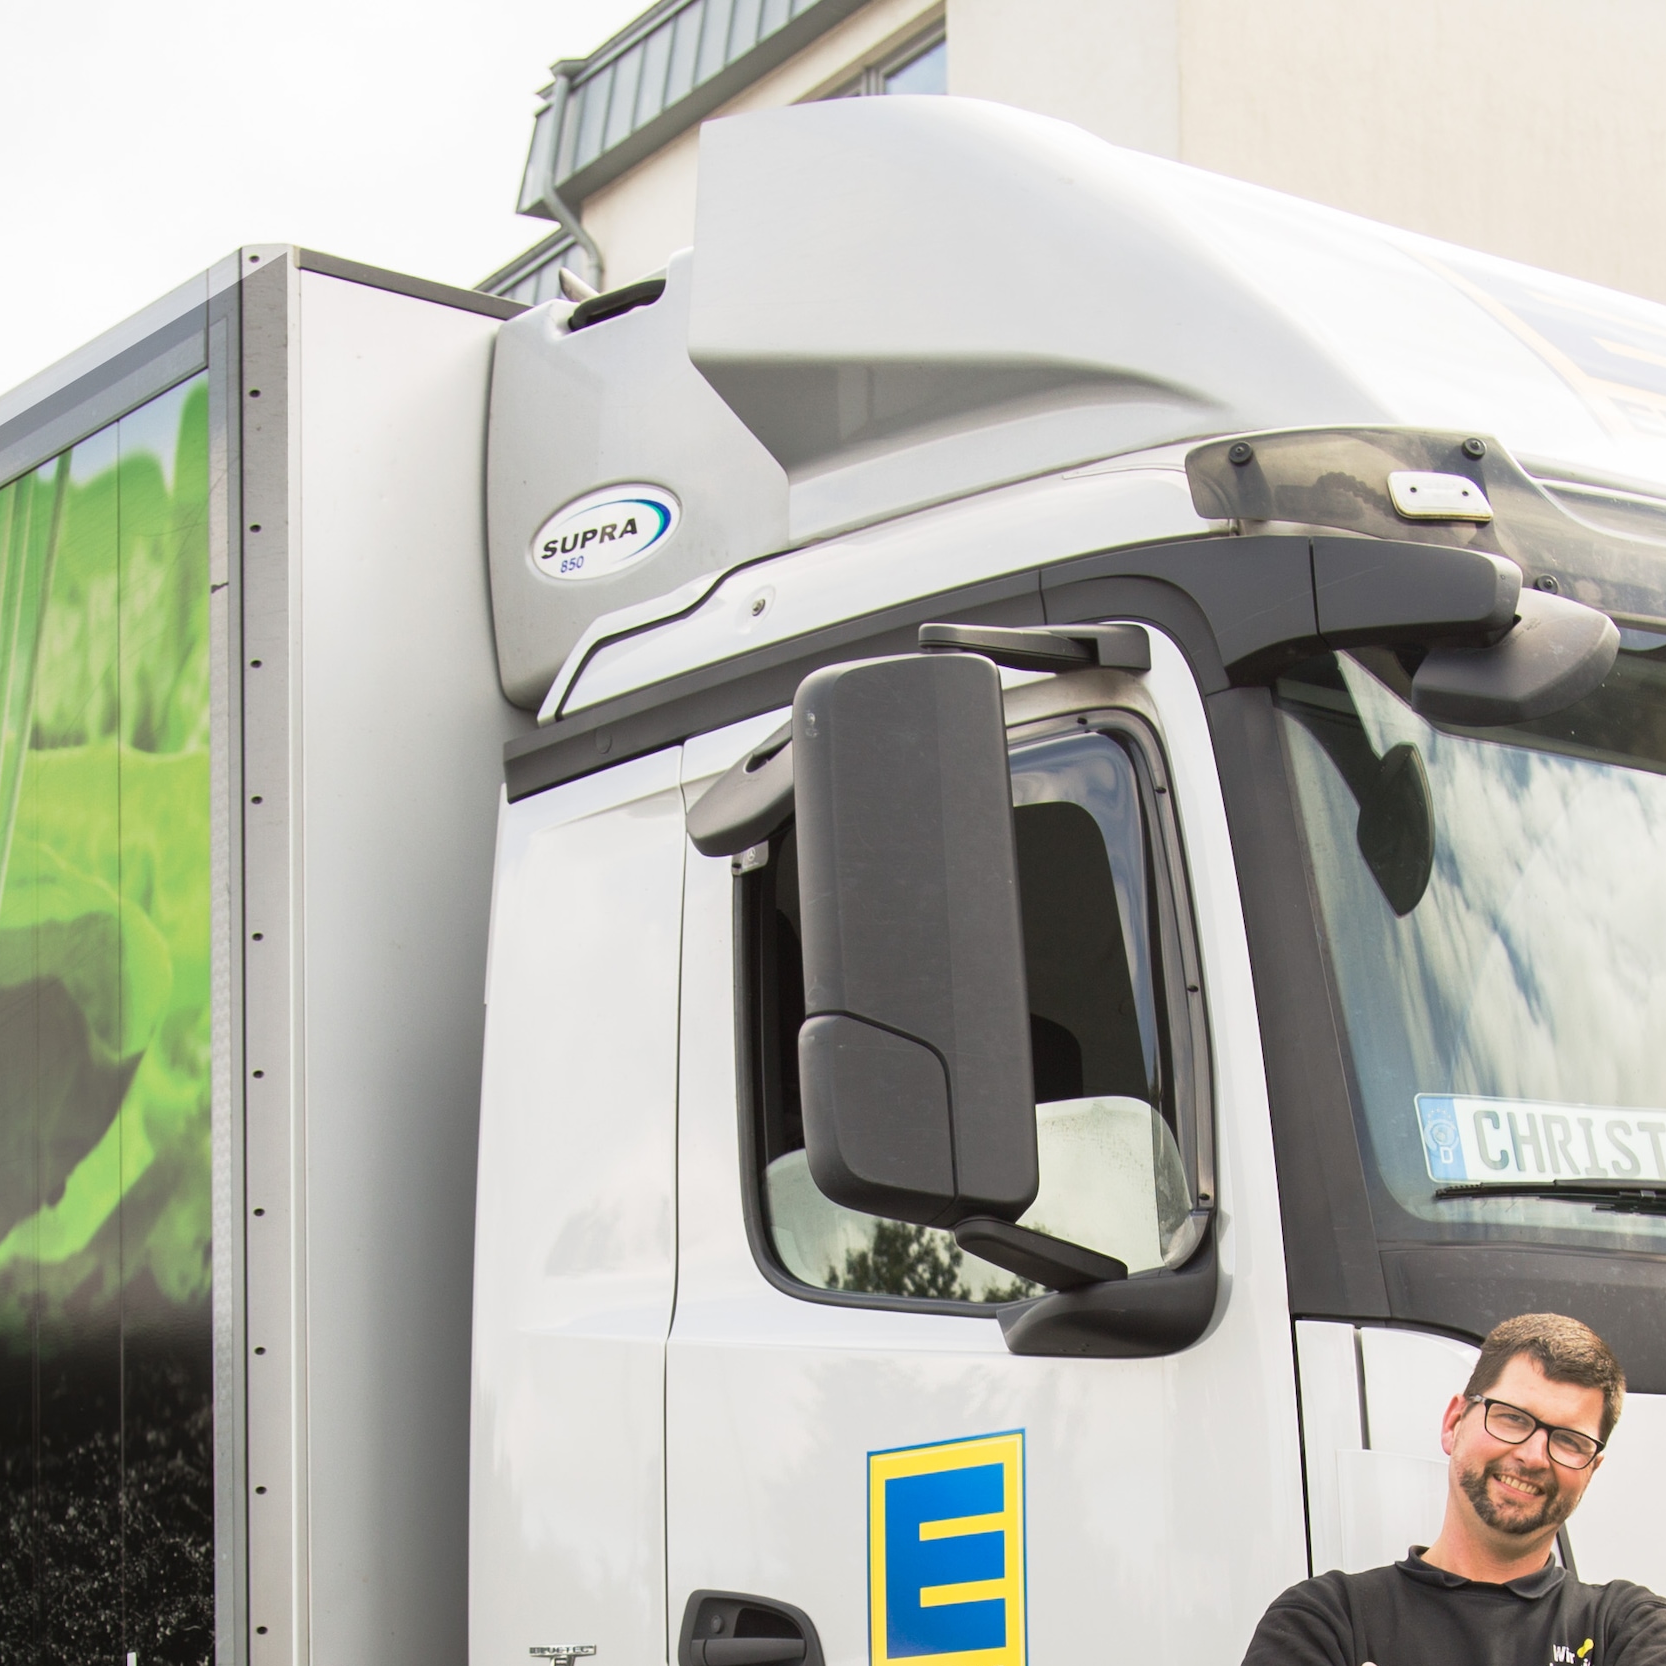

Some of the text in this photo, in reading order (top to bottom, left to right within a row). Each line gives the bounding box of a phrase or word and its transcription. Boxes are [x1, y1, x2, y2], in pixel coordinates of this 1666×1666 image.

[541, 517, 638, 560] SUPRA
[560, 555, 585, 574] 850
[1552, 1643, 1576, 1665] Wir
